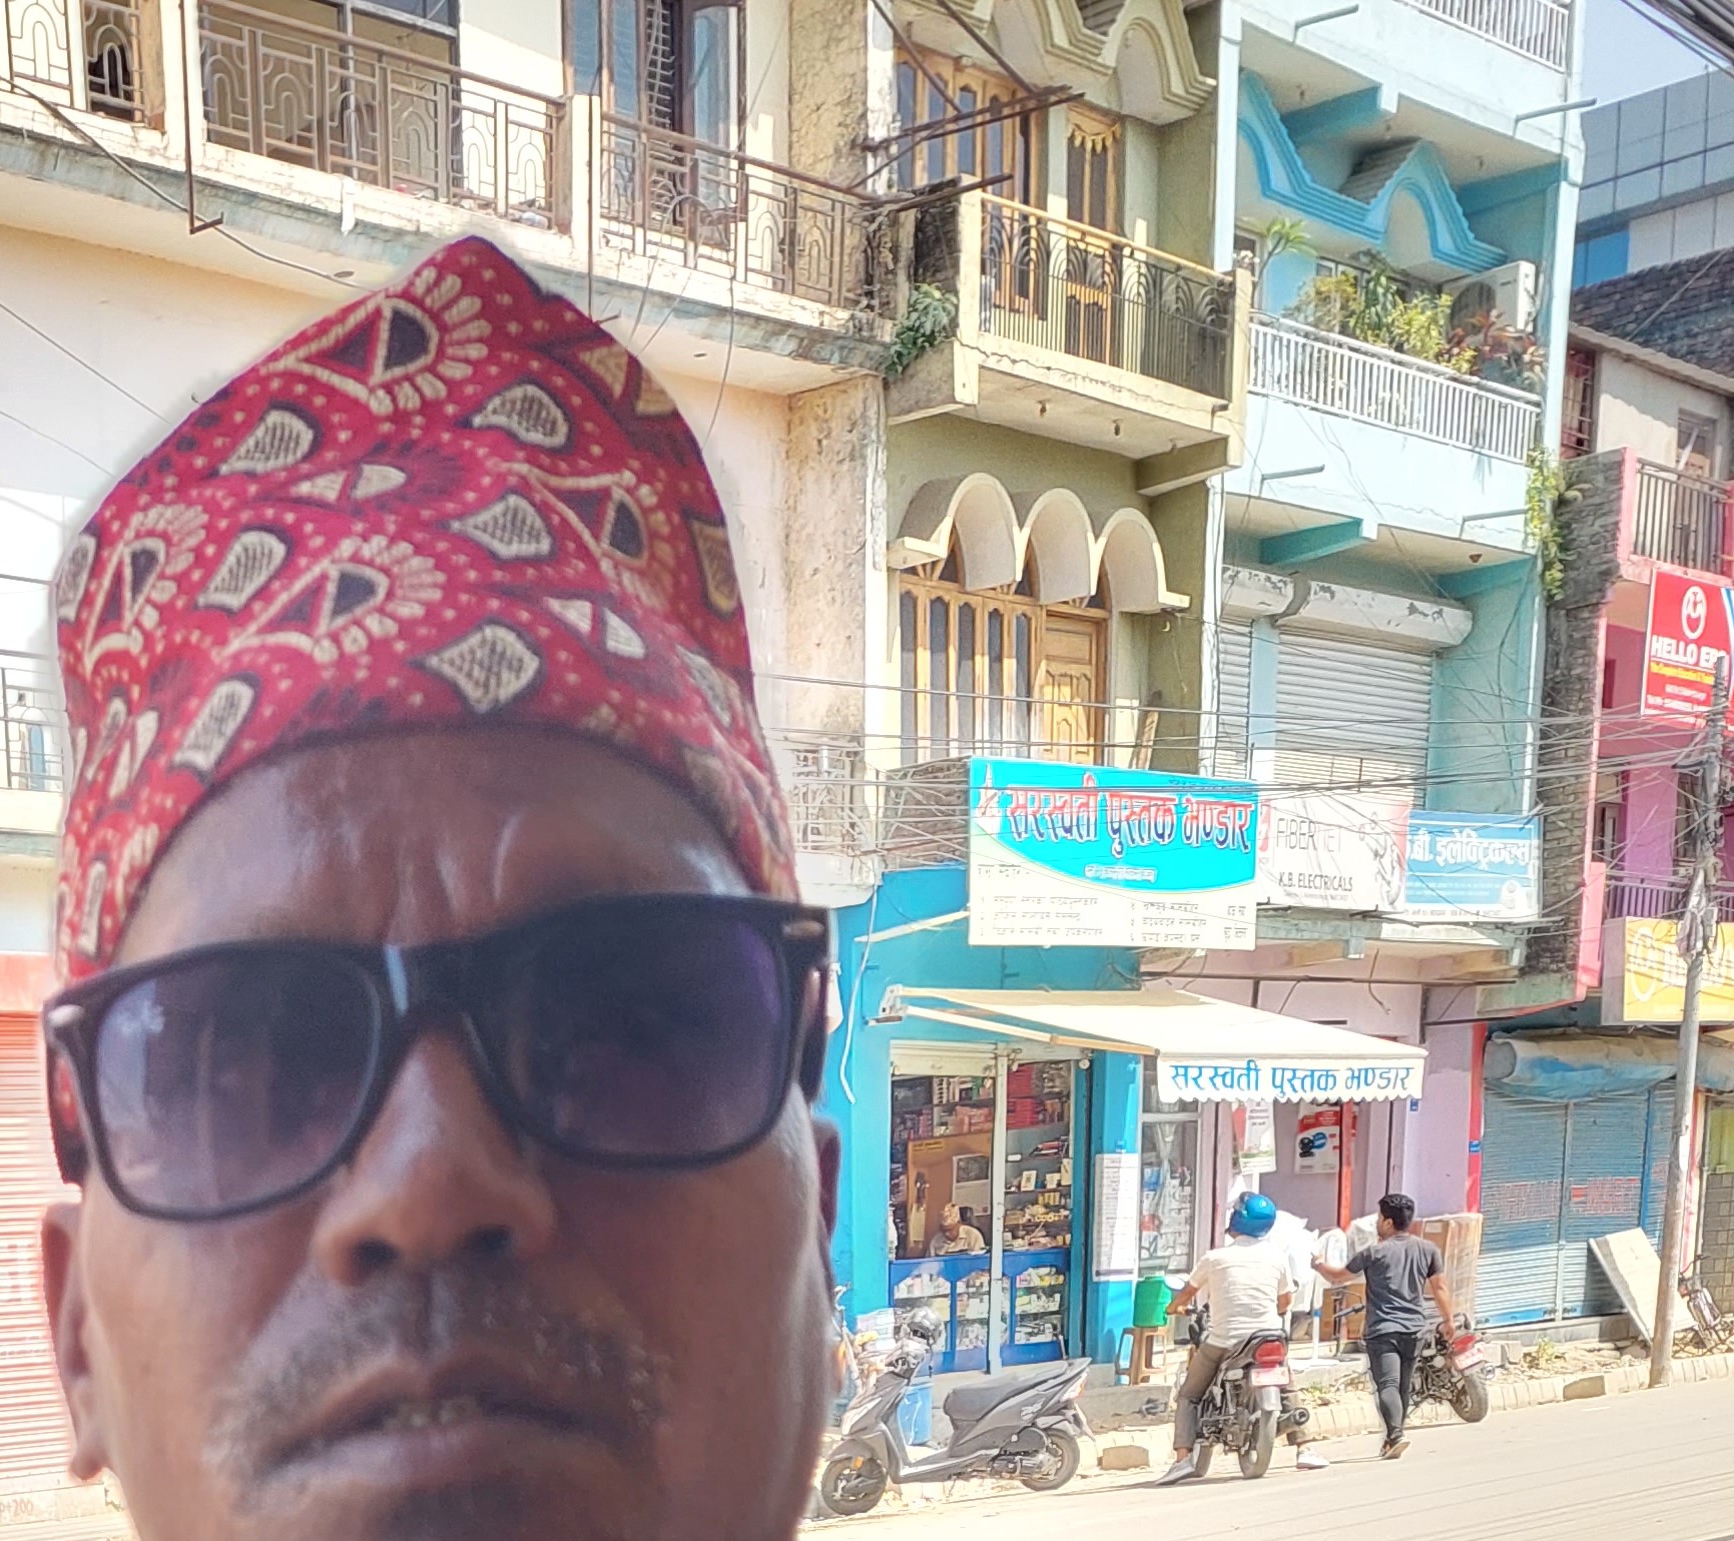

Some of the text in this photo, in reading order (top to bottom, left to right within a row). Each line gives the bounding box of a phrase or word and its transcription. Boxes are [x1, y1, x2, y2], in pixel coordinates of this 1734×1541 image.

[1650, 635, 1698, 665] HELLO
[1007, 772, 1255, 859] सरस्वती पुस्तक भण्डार
[1169, 1059, 1414, 1098] सरस्वती पुस्तक भण्डार
